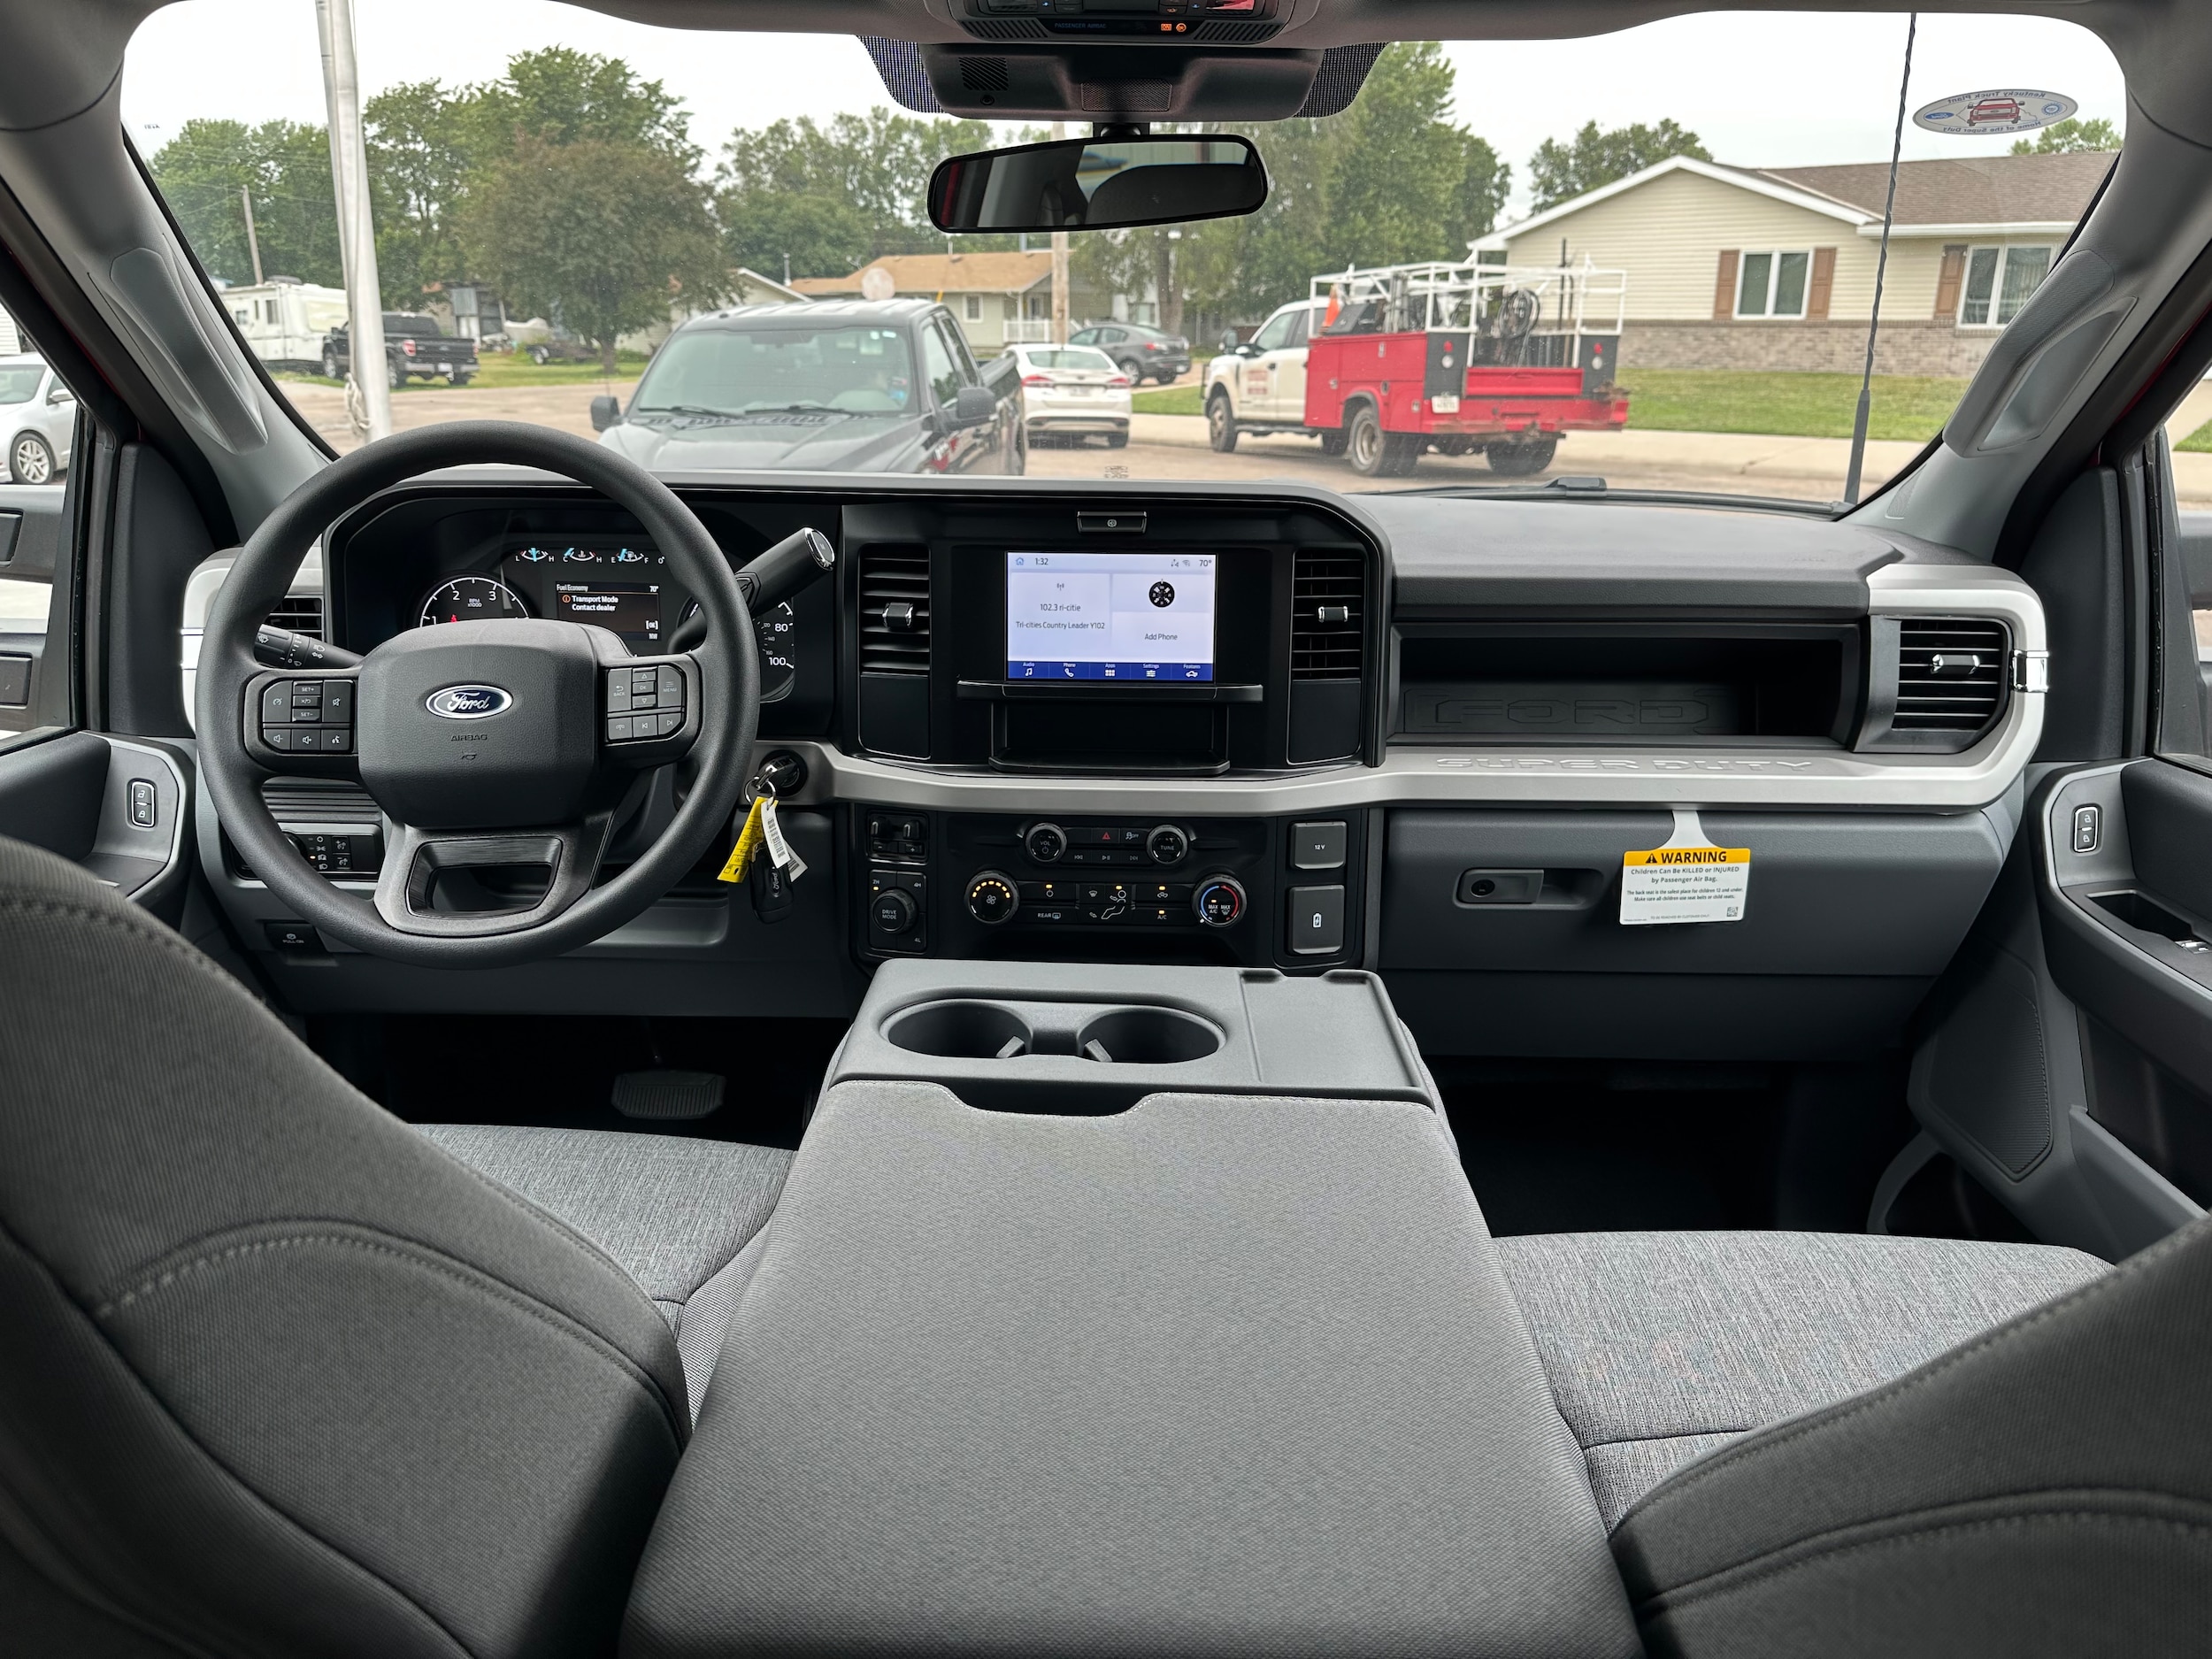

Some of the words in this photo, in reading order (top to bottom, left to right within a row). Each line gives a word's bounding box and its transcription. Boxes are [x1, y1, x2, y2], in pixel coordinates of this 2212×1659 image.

[452, 591, 460, 601] 2
[488, 591, 496, 601] 3
[572, 595, 601, 603] Transport
[775, 623, 788, 632] 80
[769, 657, 787, 665] 100
[447, 692, 491, 711] Ford
[1435, 699, 1709, 724] FORD
[1436, 757, 1640, 771] SUPER
[1653, 759, 1812, 772] DUTY
[1661, 851, 1727, 864] WARNING
